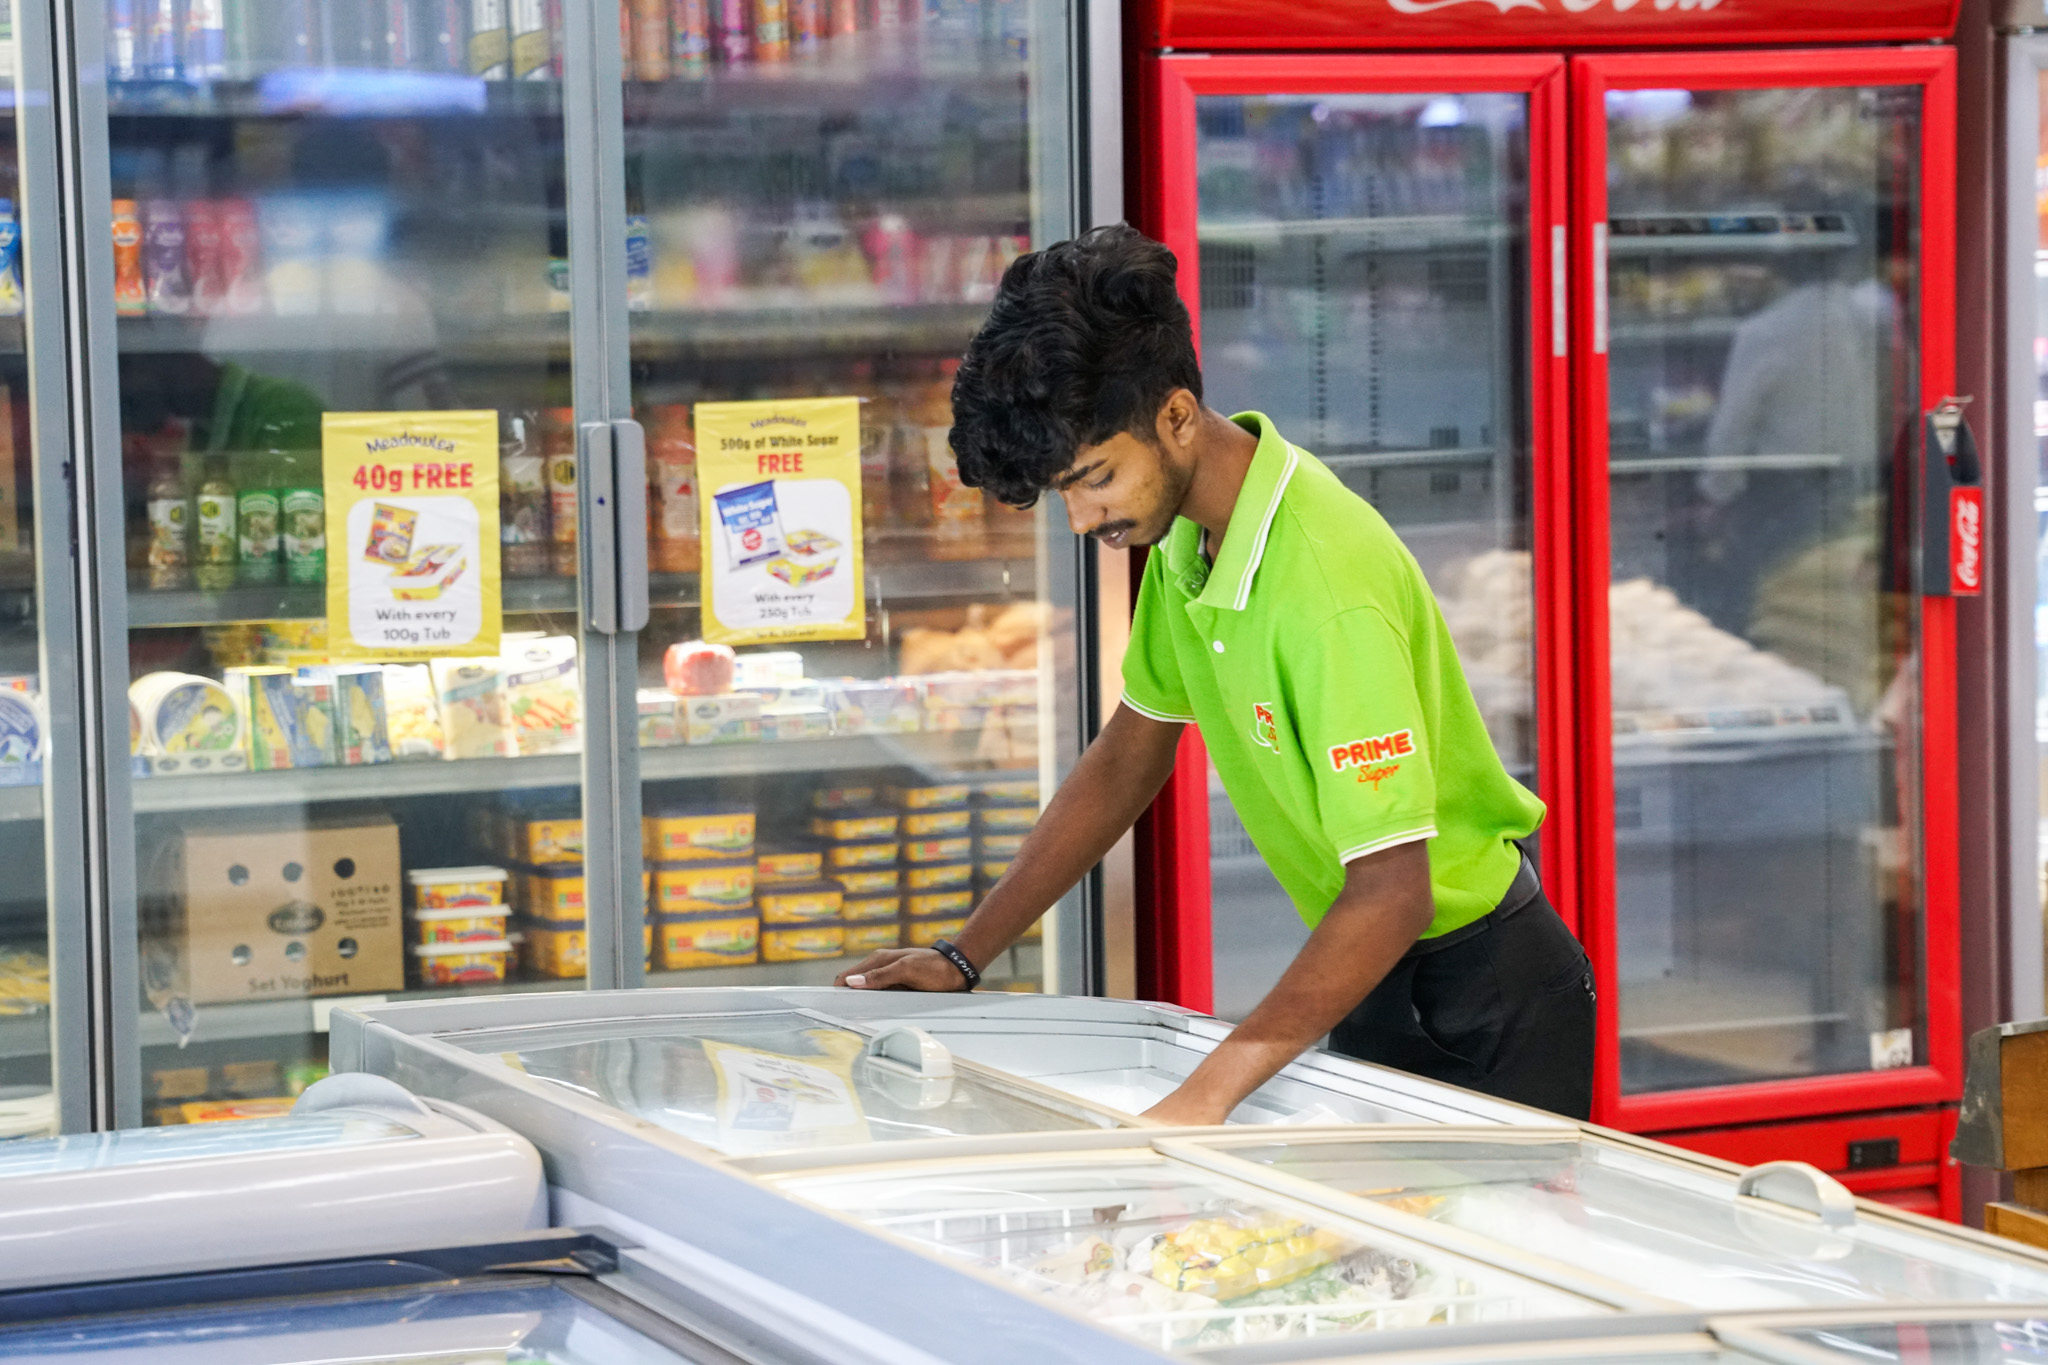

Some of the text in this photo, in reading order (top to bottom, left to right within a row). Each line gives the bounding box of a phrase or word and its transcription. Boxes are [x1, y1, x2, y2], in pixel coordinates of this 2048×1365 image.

[720, 434, 839, 451] 500g of White Sugar
[758, 453, 804, 475] FREE
[353, 463, 473, 493] 40g FREE
[755, 593, 815, 604] With every
[375, 609, 457, 623] With every
[383, 627, 451, 642] 100g Tub
[1330, 731, 1414, 771] PRIME
[1357, 764, 1401, 791] Super
[249, 972, 349, 992] Set Yoghurt
